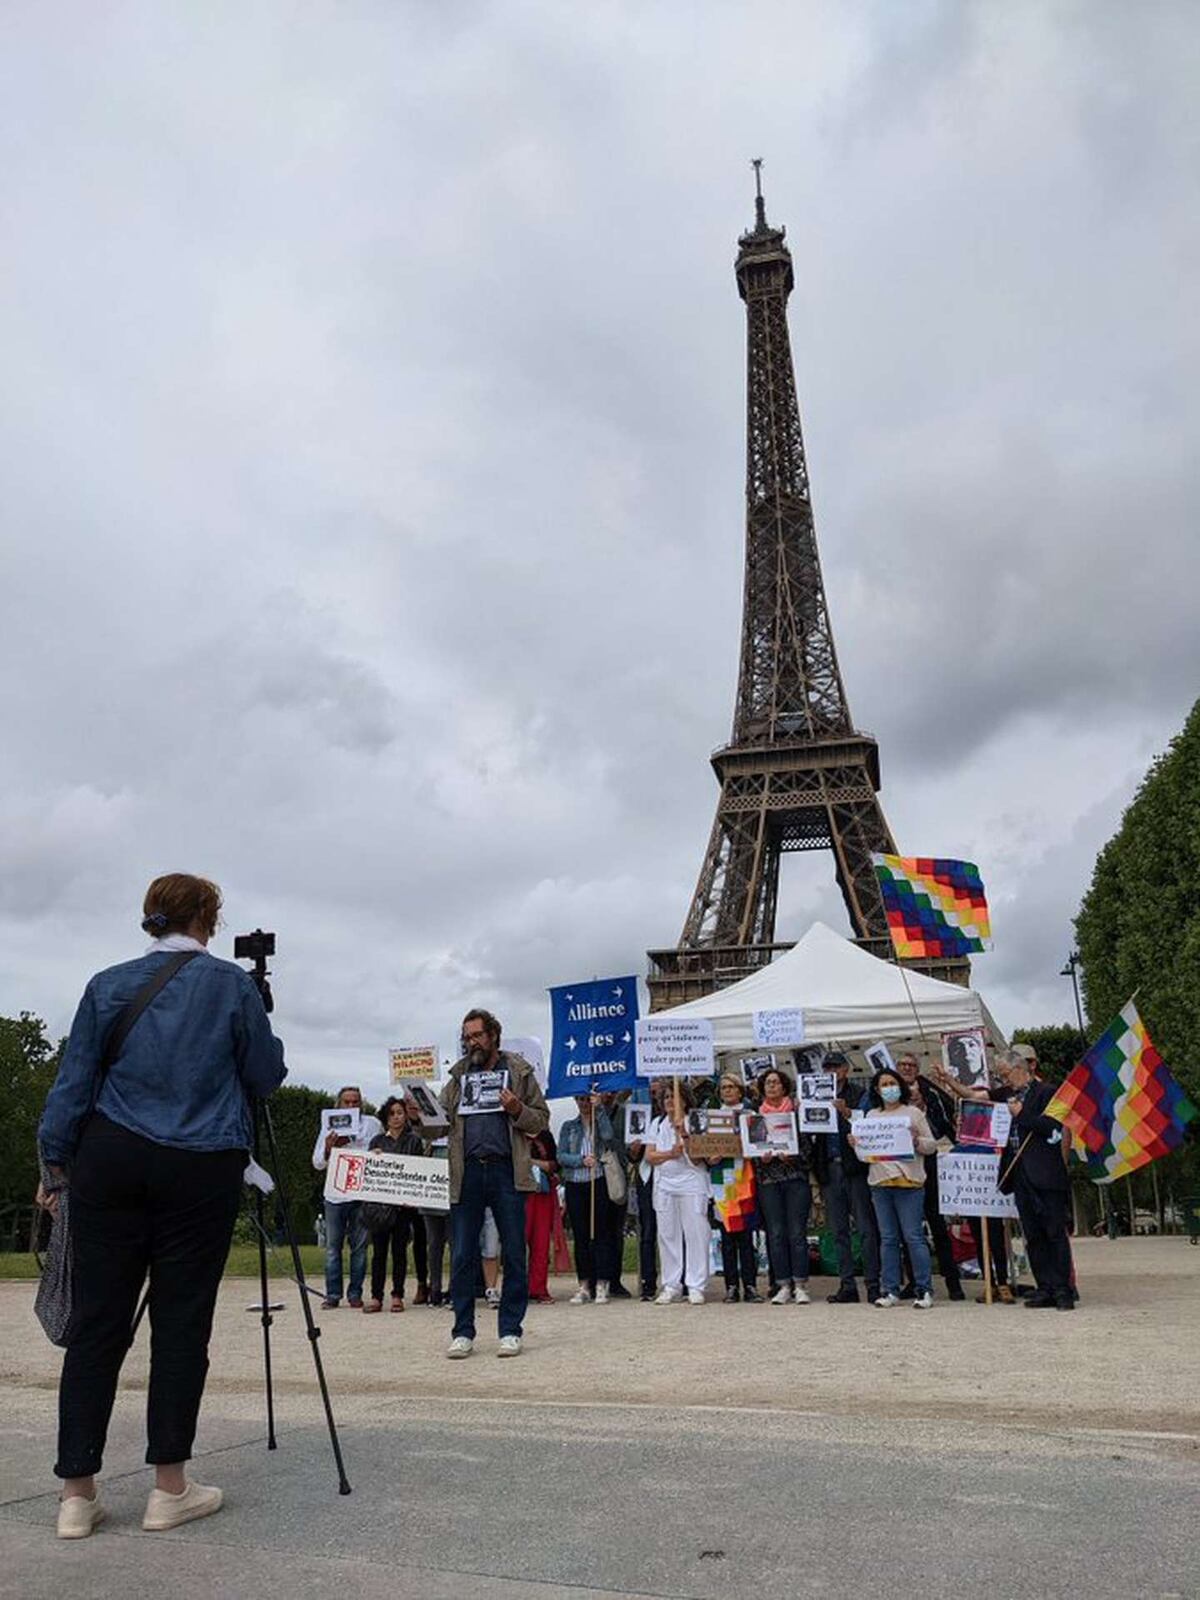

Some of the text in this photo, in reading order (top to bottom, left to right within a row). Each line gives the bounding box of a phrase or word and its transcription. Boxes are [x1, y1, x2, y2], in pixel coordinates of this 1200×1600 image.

[568, 1003, 625, 1020] Alliance
[588, 1031, 614, 1048] des
[566, 1060, 627, 1077] femmes
[952, 1160, 999, 1170] Allian
[940, 1171, 996, 1182] des Fem
[956, 1186, 989, 1197] pour
[941, 1195, 1012, 1206] Démocrat
